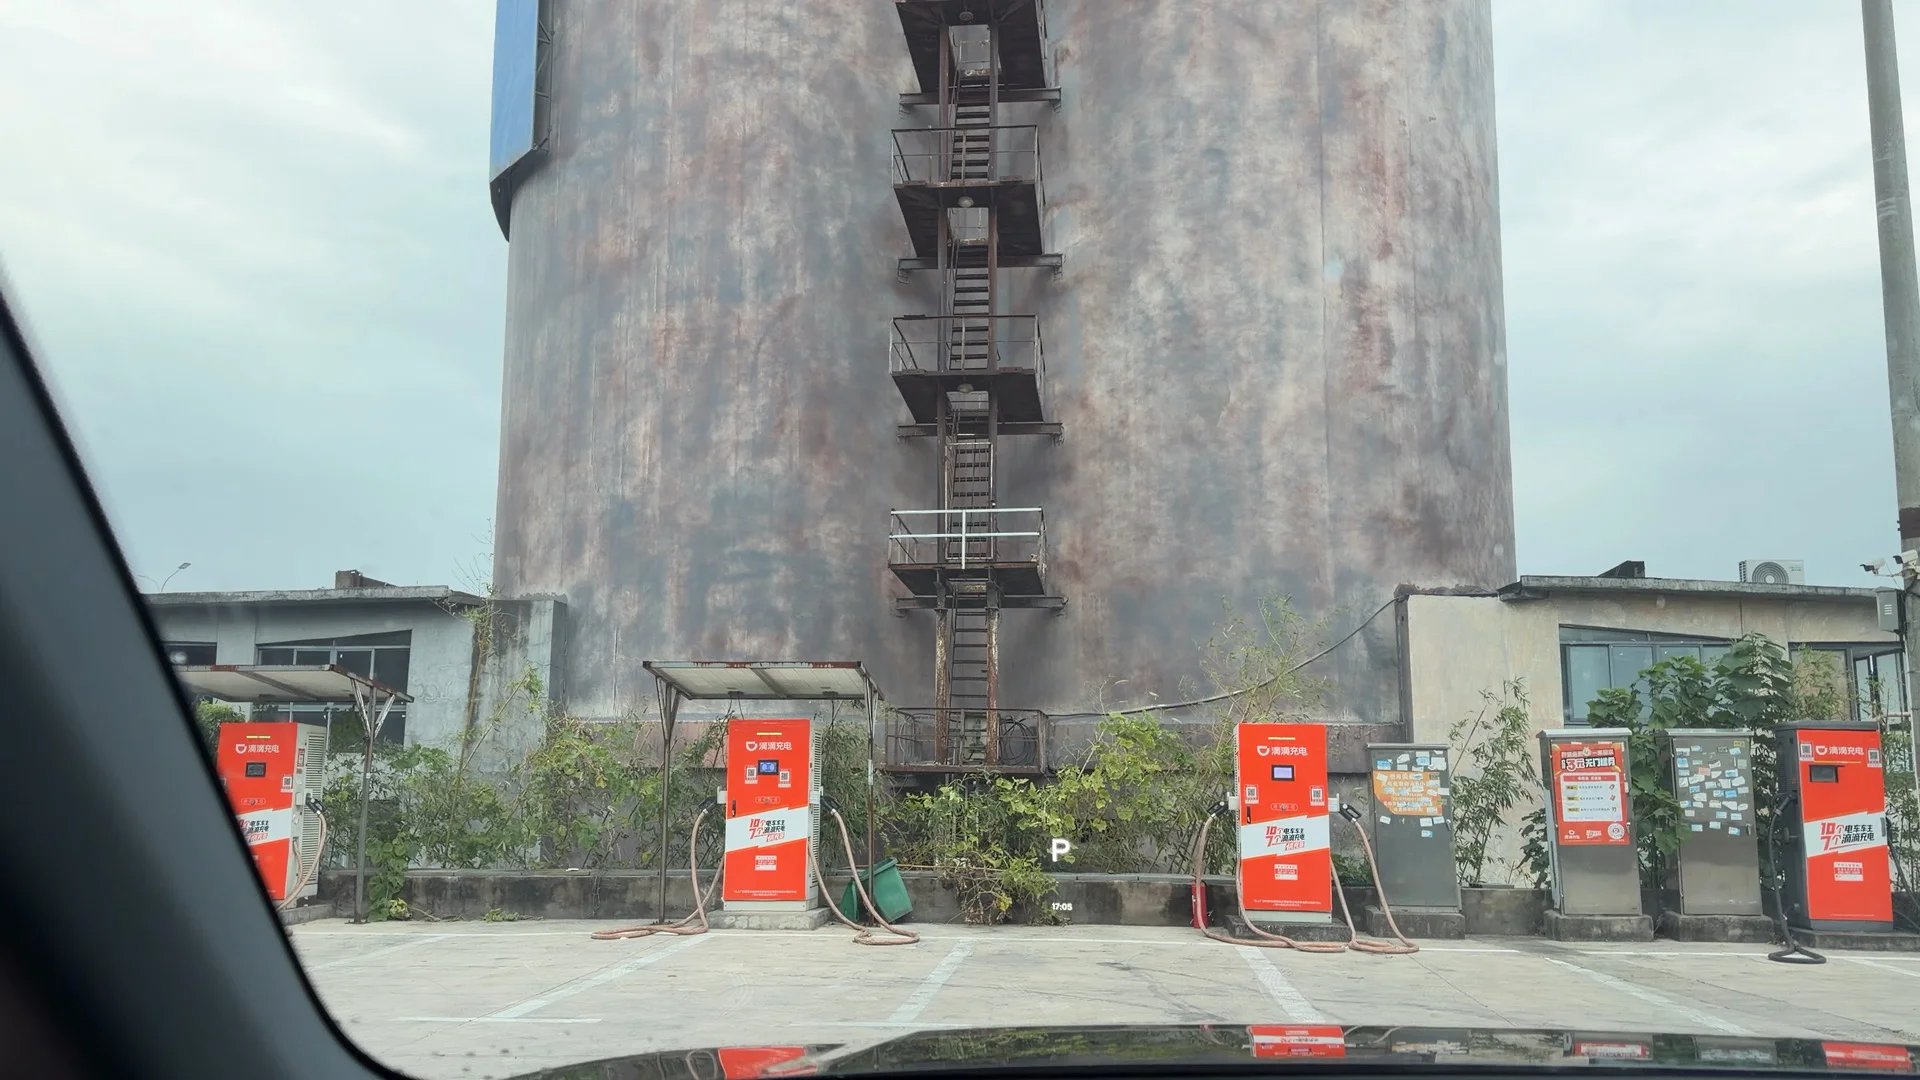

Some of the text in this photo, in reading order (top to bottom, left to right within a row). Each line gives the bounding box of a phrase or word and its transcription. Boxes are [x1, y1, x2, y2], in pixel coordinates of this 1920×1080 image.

[759, 741, 792, 751] 滴滴充电
[1271, 746, 1308, 756] 滴滴充电
[1829, 746, 1865, 756] 滴滴充电
[1820, 822, 1874, 835] 10个电车车主
[1820, 833, 1875, 851] 7个滴滴充电
[1052, 838, 1070, 862] P
[1052, 902, 1073, 911] 17:05
